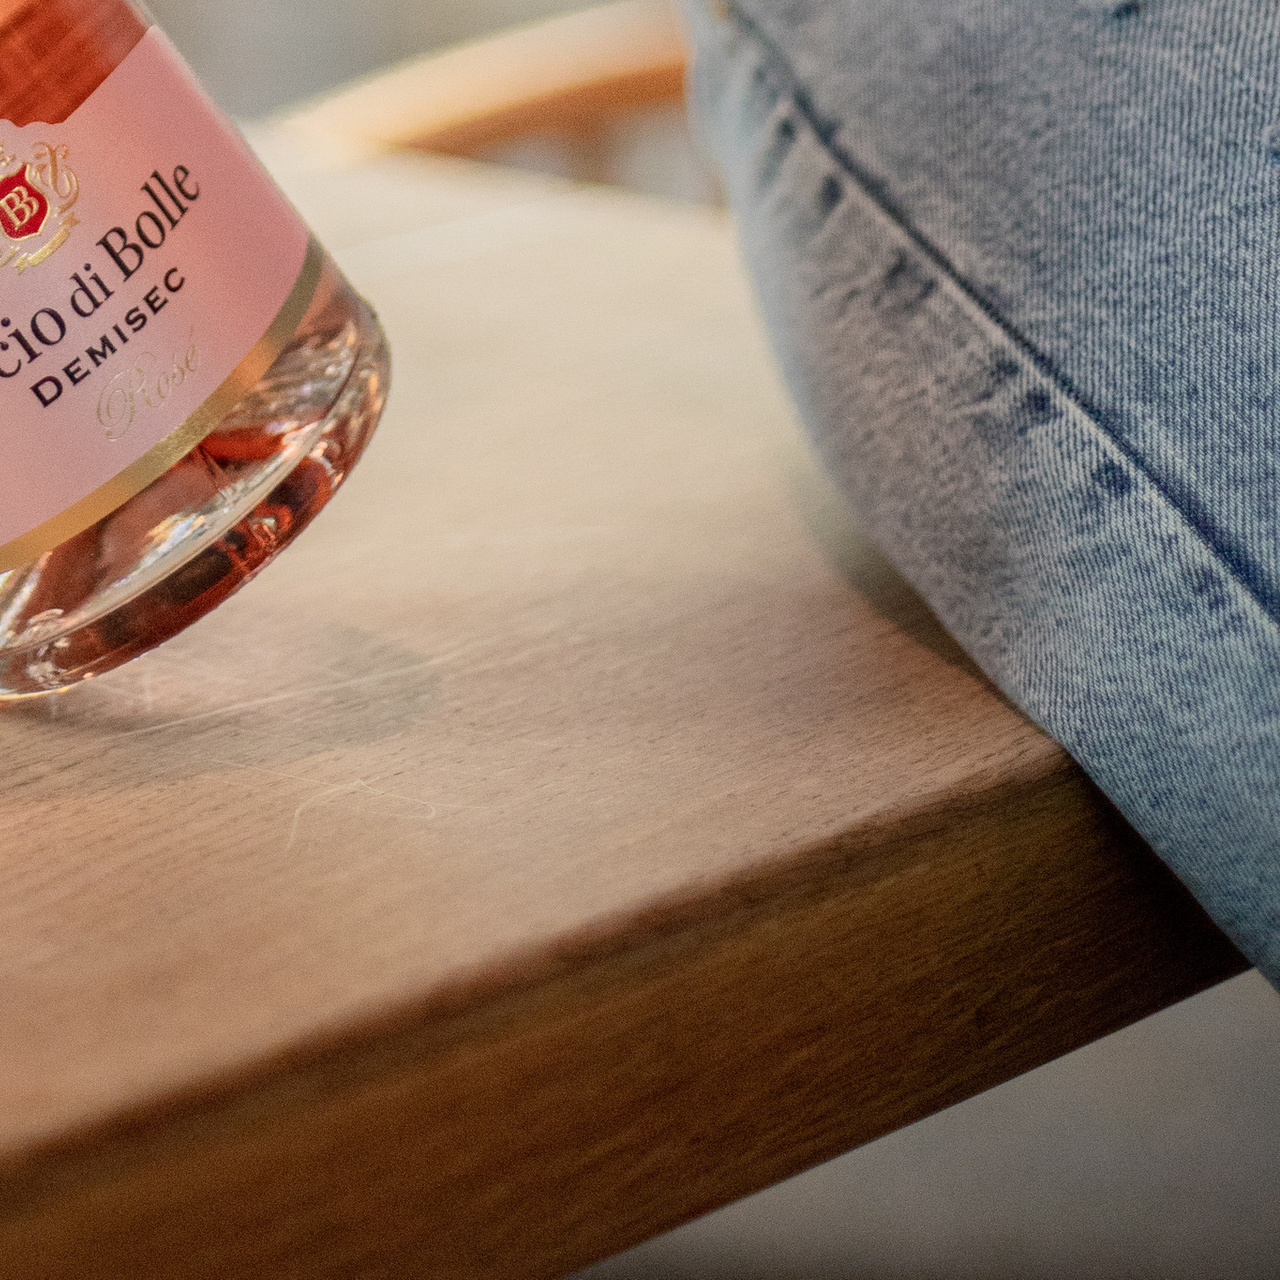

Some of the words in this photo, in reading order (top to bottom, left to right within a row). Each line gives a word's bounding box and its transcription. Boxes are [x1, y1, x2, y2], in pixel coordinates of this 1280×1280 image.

[69, 262, 116, 319] di
[94, 163, 201, 284] Bolle
[28, 266, 187, 409] DEMISEC
